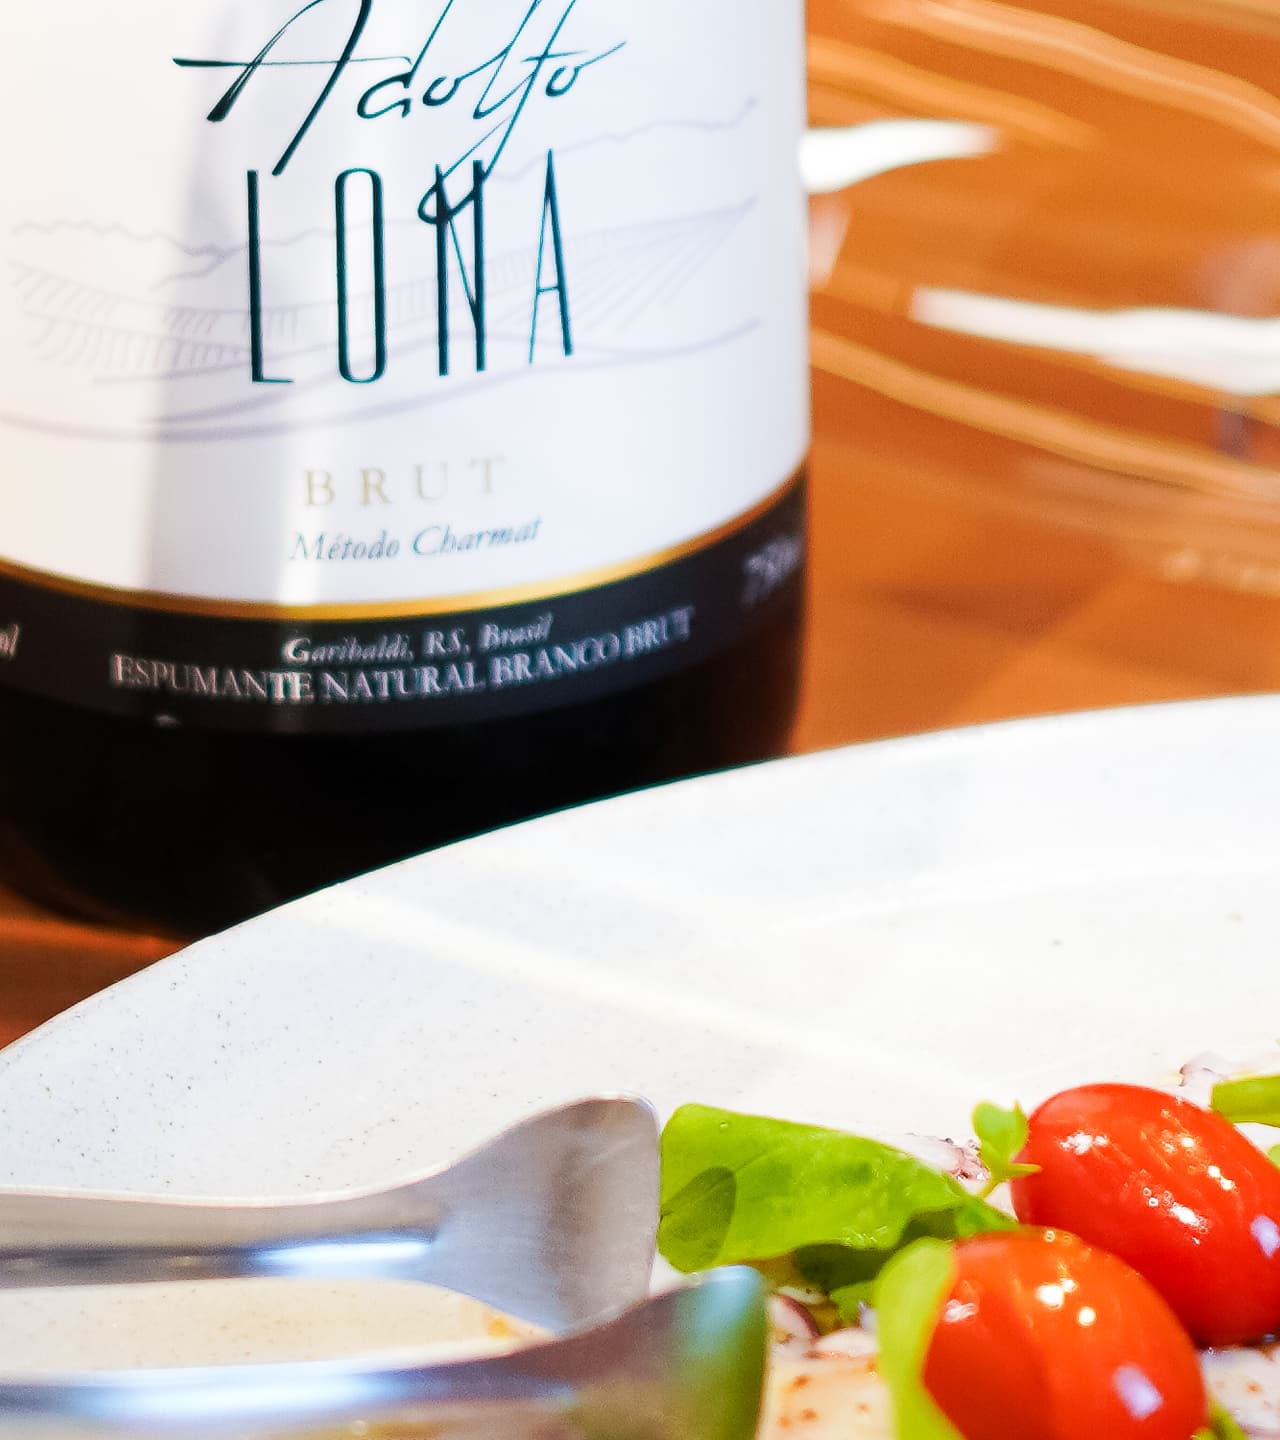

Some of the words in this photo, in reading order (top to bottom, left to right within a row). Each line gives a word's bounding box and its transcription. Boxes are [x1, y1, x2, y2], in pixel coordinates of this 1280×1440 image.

[246, 148, 573, 385] LONA
[303, 455, 506, 507] BRUT
[289, 528, 401, 561] Método
[411, 515, 543, 557] Charmat
[110, 651, 315, 703] ESPUMANTE
[319, 662, 484, 702] NATURAL
[486, 633, 620, 687] BRANCO
[622, 605, 695, 657] BRUT
